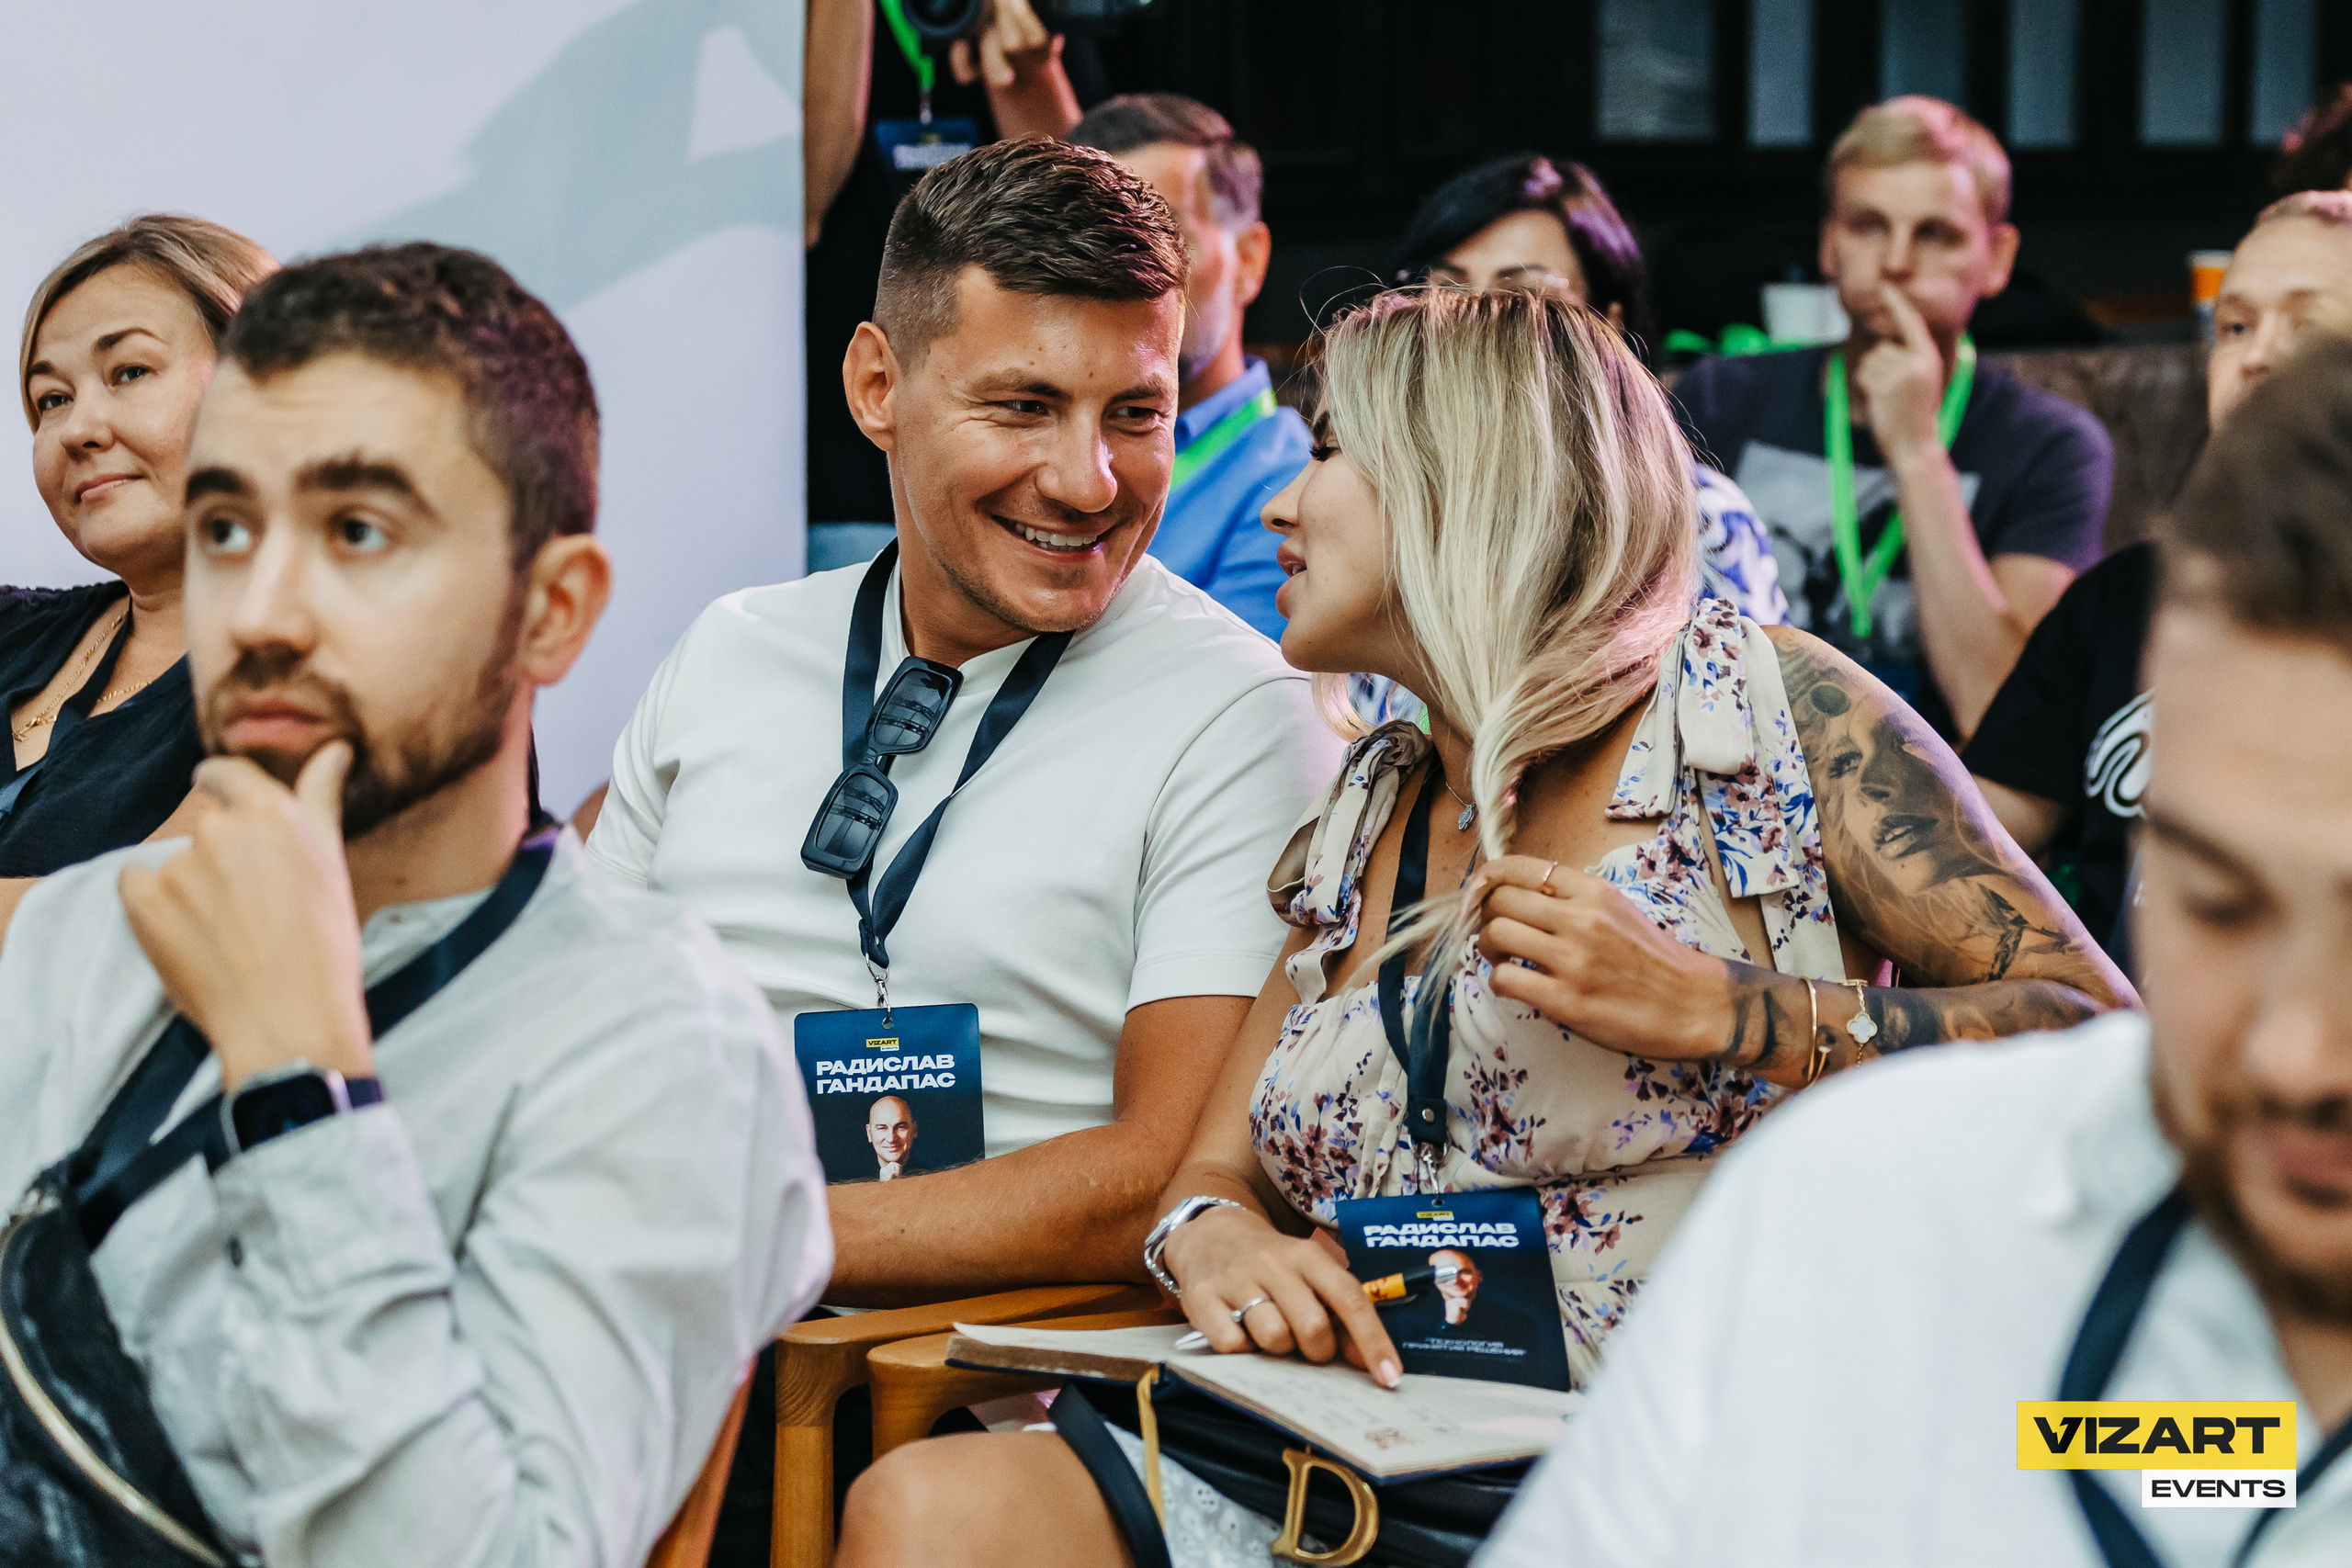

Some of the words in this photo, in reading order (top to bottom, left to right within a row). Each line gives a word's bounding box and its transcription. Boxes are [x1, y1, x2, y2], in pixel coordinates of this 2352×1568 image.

[816, 1054, 956, 1076] РАДИСЛАВ
[816, 1072, 956, 1094] ГАНДАПАС
[1363, 1223, 1517, 1236] РАДИСЛАВ
[1365, 1235, 1520, 1248] ГАНДАПАС
